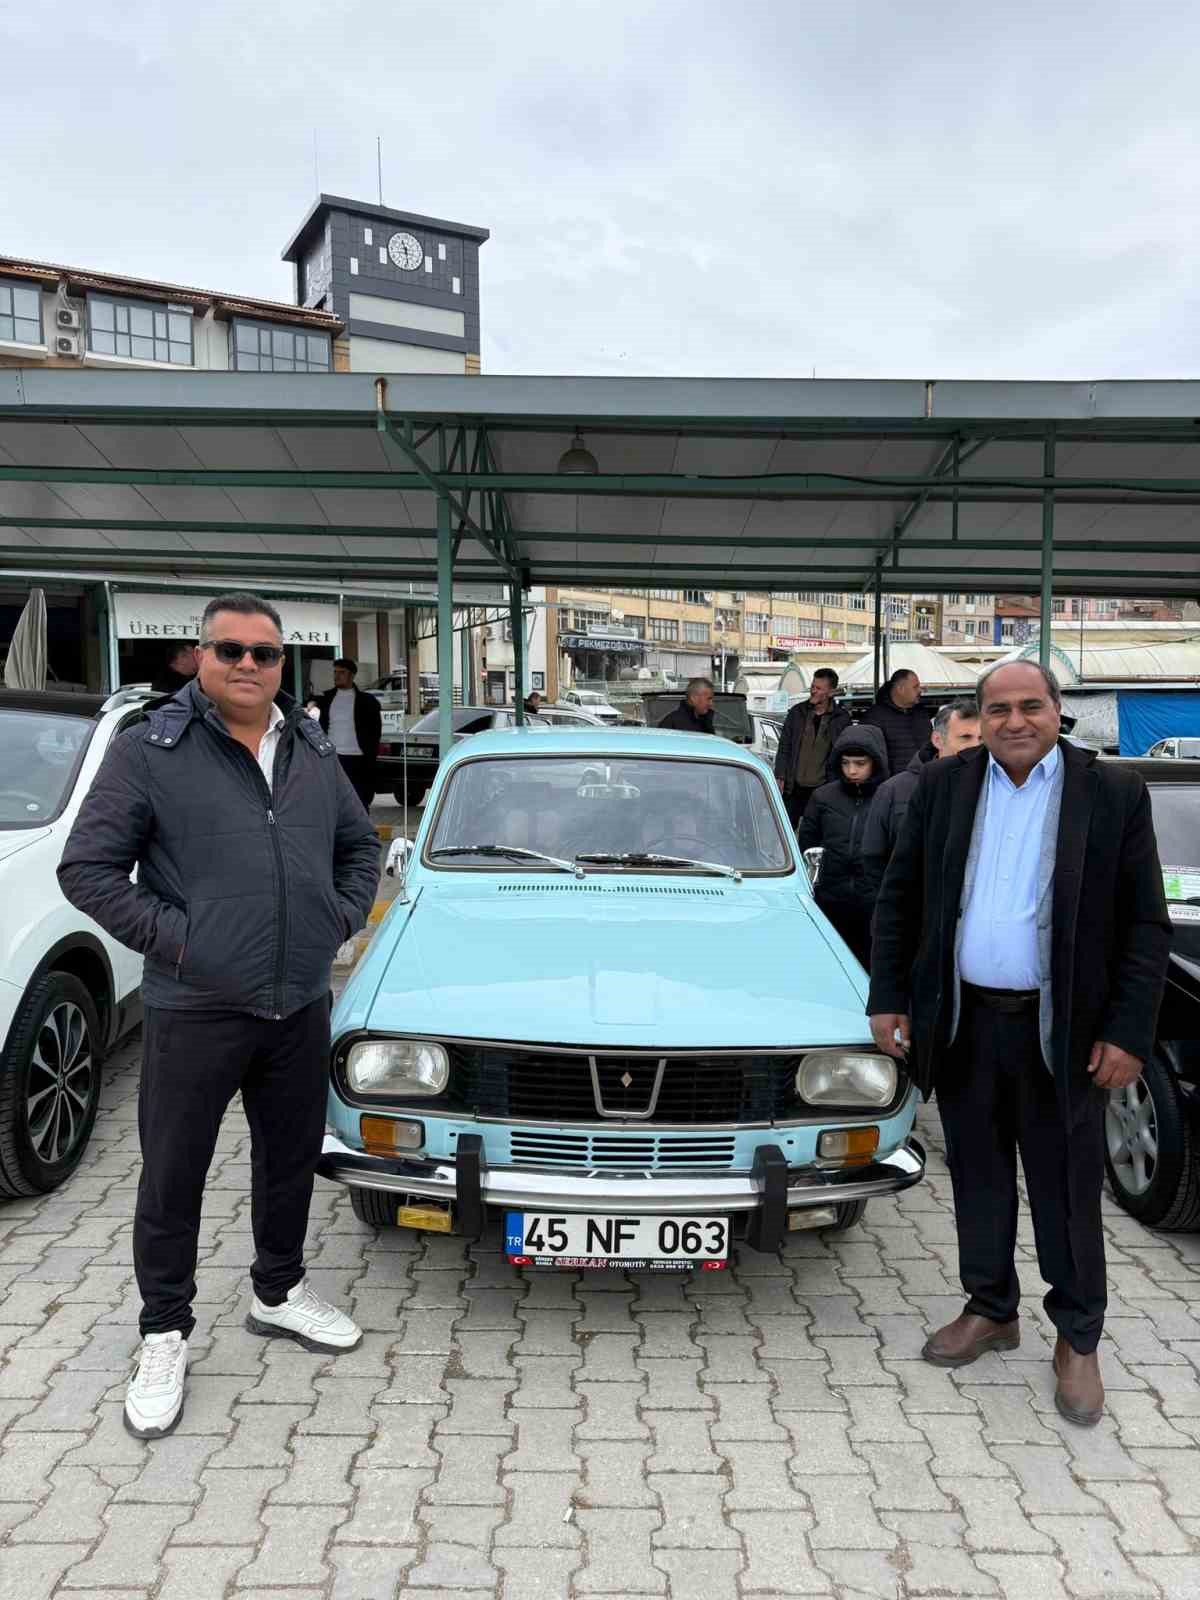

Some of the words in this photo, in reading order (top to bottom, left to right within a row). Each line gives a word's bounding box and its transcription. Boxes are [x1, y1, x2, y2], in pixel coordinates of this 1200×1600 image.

[129, 620, 200, 636] ÜRETİ
[290, 631, 329, 642] ARI
[507, 1235, 522, 1246] TR
[524, 1218, 569, 1252] 45
[586, 1219, 640, 1254] NF
[658, 1221, 725, 1254] 063
[609, 1260, 647, 1269] OTOMOTİV
